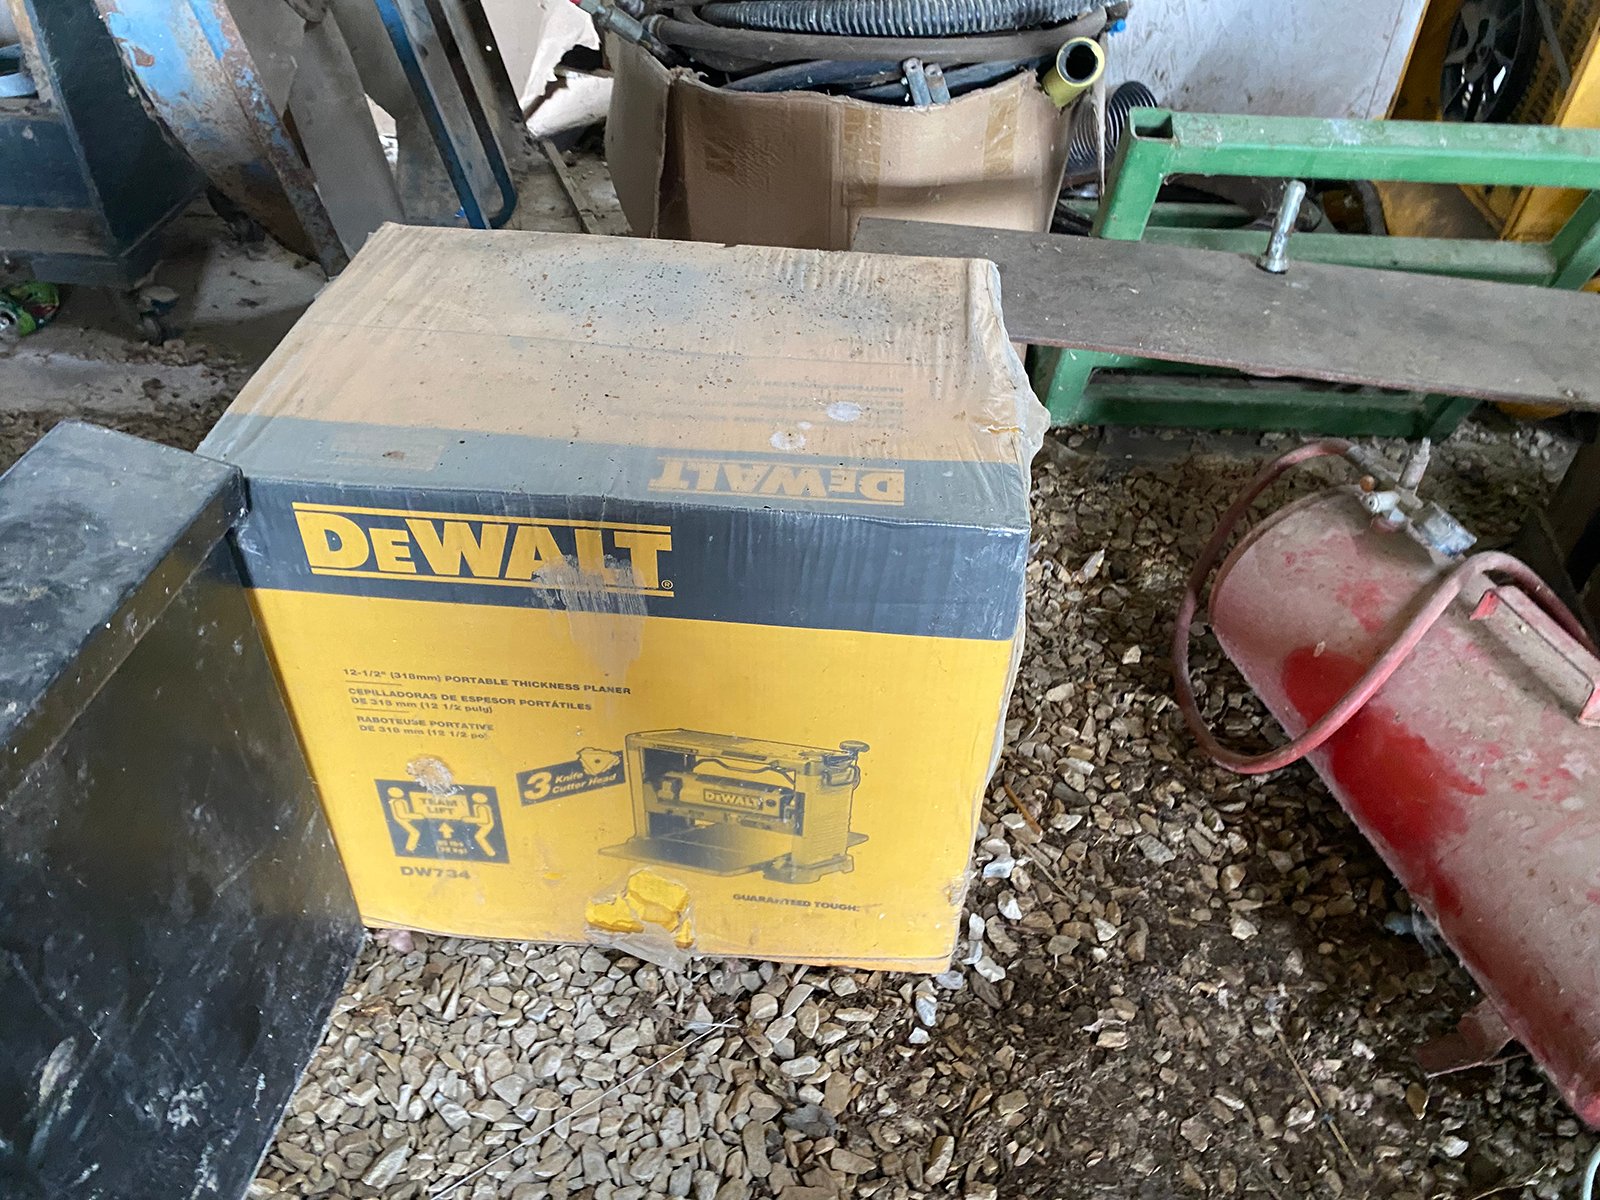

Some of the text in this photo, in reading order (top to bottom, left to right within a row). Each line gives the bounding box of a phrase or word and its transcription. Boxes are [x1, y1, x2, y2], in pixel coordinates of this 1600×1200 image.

[344, 668, 631, 695] 12-1/2" (318mm) PORTABLE THICKNESS PLANER
[348, 687, 592, 711] CEPILLADORAS DE ESPESOR PORTÁTILES
[351, 696, 367, 705] DE
[371, 698, 393, 706] 318
[420, 701, 439, 710] (12
[443, 703, 462, 712] 1/2
[465, 705, 493, 714] pulg)
[357, 715, 494, 731] RABOTEUSE PORTATIVE
[360, 725, 376, 733] DE
[427, 729, 445, 737] (12
[450, 730, 468, 738] 1/2
[523, 771, 584, 800] 3 Knife
[552, 773, 617, 794] Cutter Head
[421, 798, 458, 807] TEAM
[427, 805, 453, 814] LIFT
[400, 866, 470, 879] DW734
[733, 893, 811, 907] GUARANTEED
